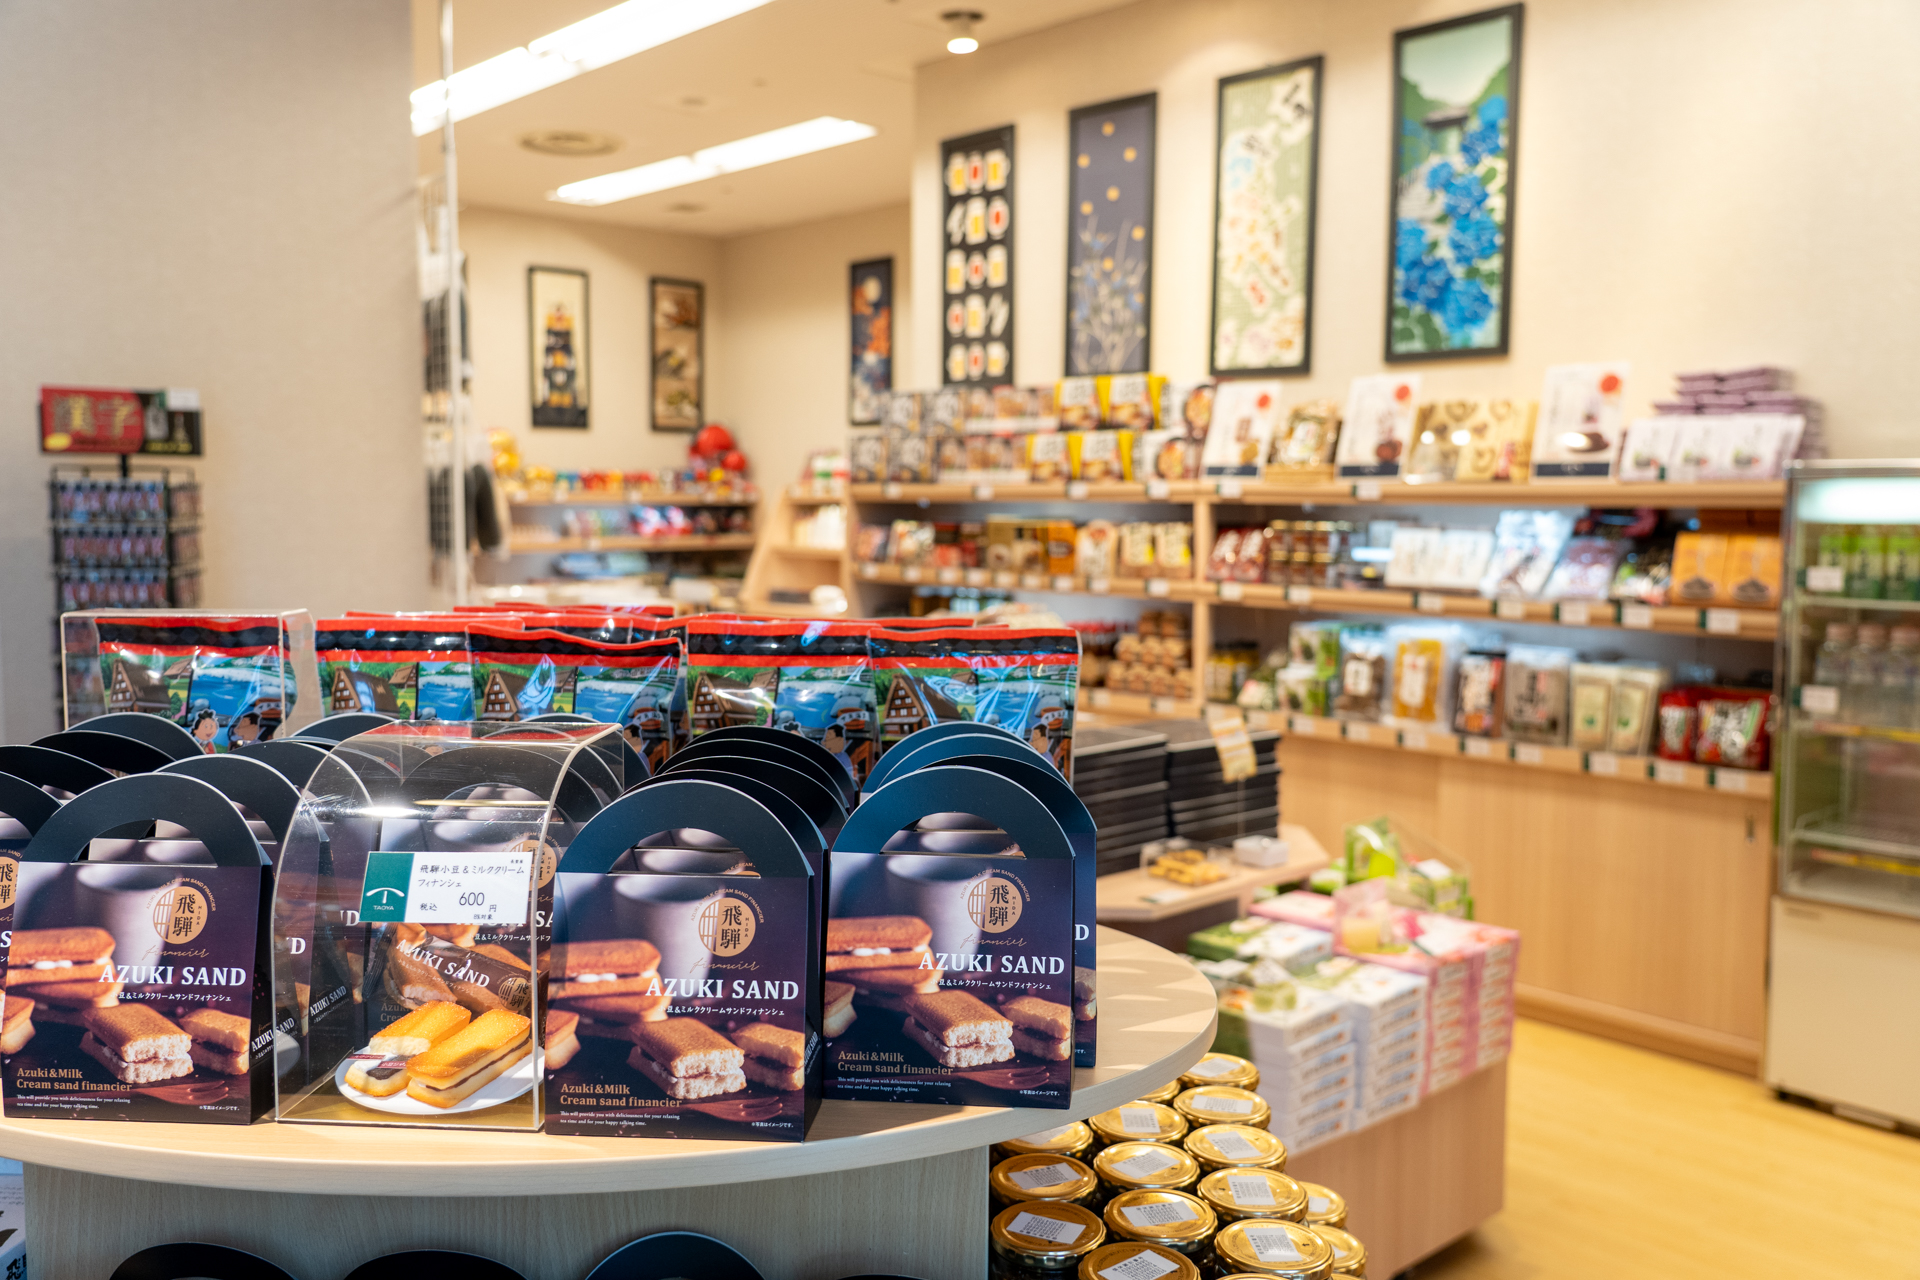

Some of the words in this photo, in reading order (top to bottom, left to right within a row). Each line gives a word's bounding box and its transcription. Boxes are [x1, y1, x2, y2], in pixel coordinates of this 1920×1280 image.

[418, 879, 462, 888] フィナンシェ
[420, 903, 438, 911] 税込
[459, 892, 485, 906] 600
[488, 904, 497, 912] 円
[989, 885, 1009, 926] 飛騨
[173, 894, 196, 937] 飛騨
[720, 905, 742, 949] 飛騨
[396, 939, 444, 970] AZUKI
[444, 959, 490, 988] SAND
[918, 952, 992, 972] AZUKI
[1001, 955, 1064, 974] SAND
[99, 965, 174, 984] AZUKI
[181, 967, 246, 986] SAND
[645, 978, 723, 998] AZUKI
[732, 980, 799, 999] SAND
[310, 998, 330, 1016] AZUKI
[329, 986, 347, 1003] SAND
[252, 1030, 274, 1052] AZUKI
[838, 1062, 872, 1072] Cream
[875, 1065, 900, 1073] sand
[903, 1064, 953, 1075] financier
[16, 1079, 51, 1089] Cream
[54, 1081, 79, 1090] sand
[82, 1081, 132, 1091] financier
[560, 1095, 596, 1105] Cream
[600, 1097, 626, 1106] sand
[629, 1097, 682, 1107] financier
